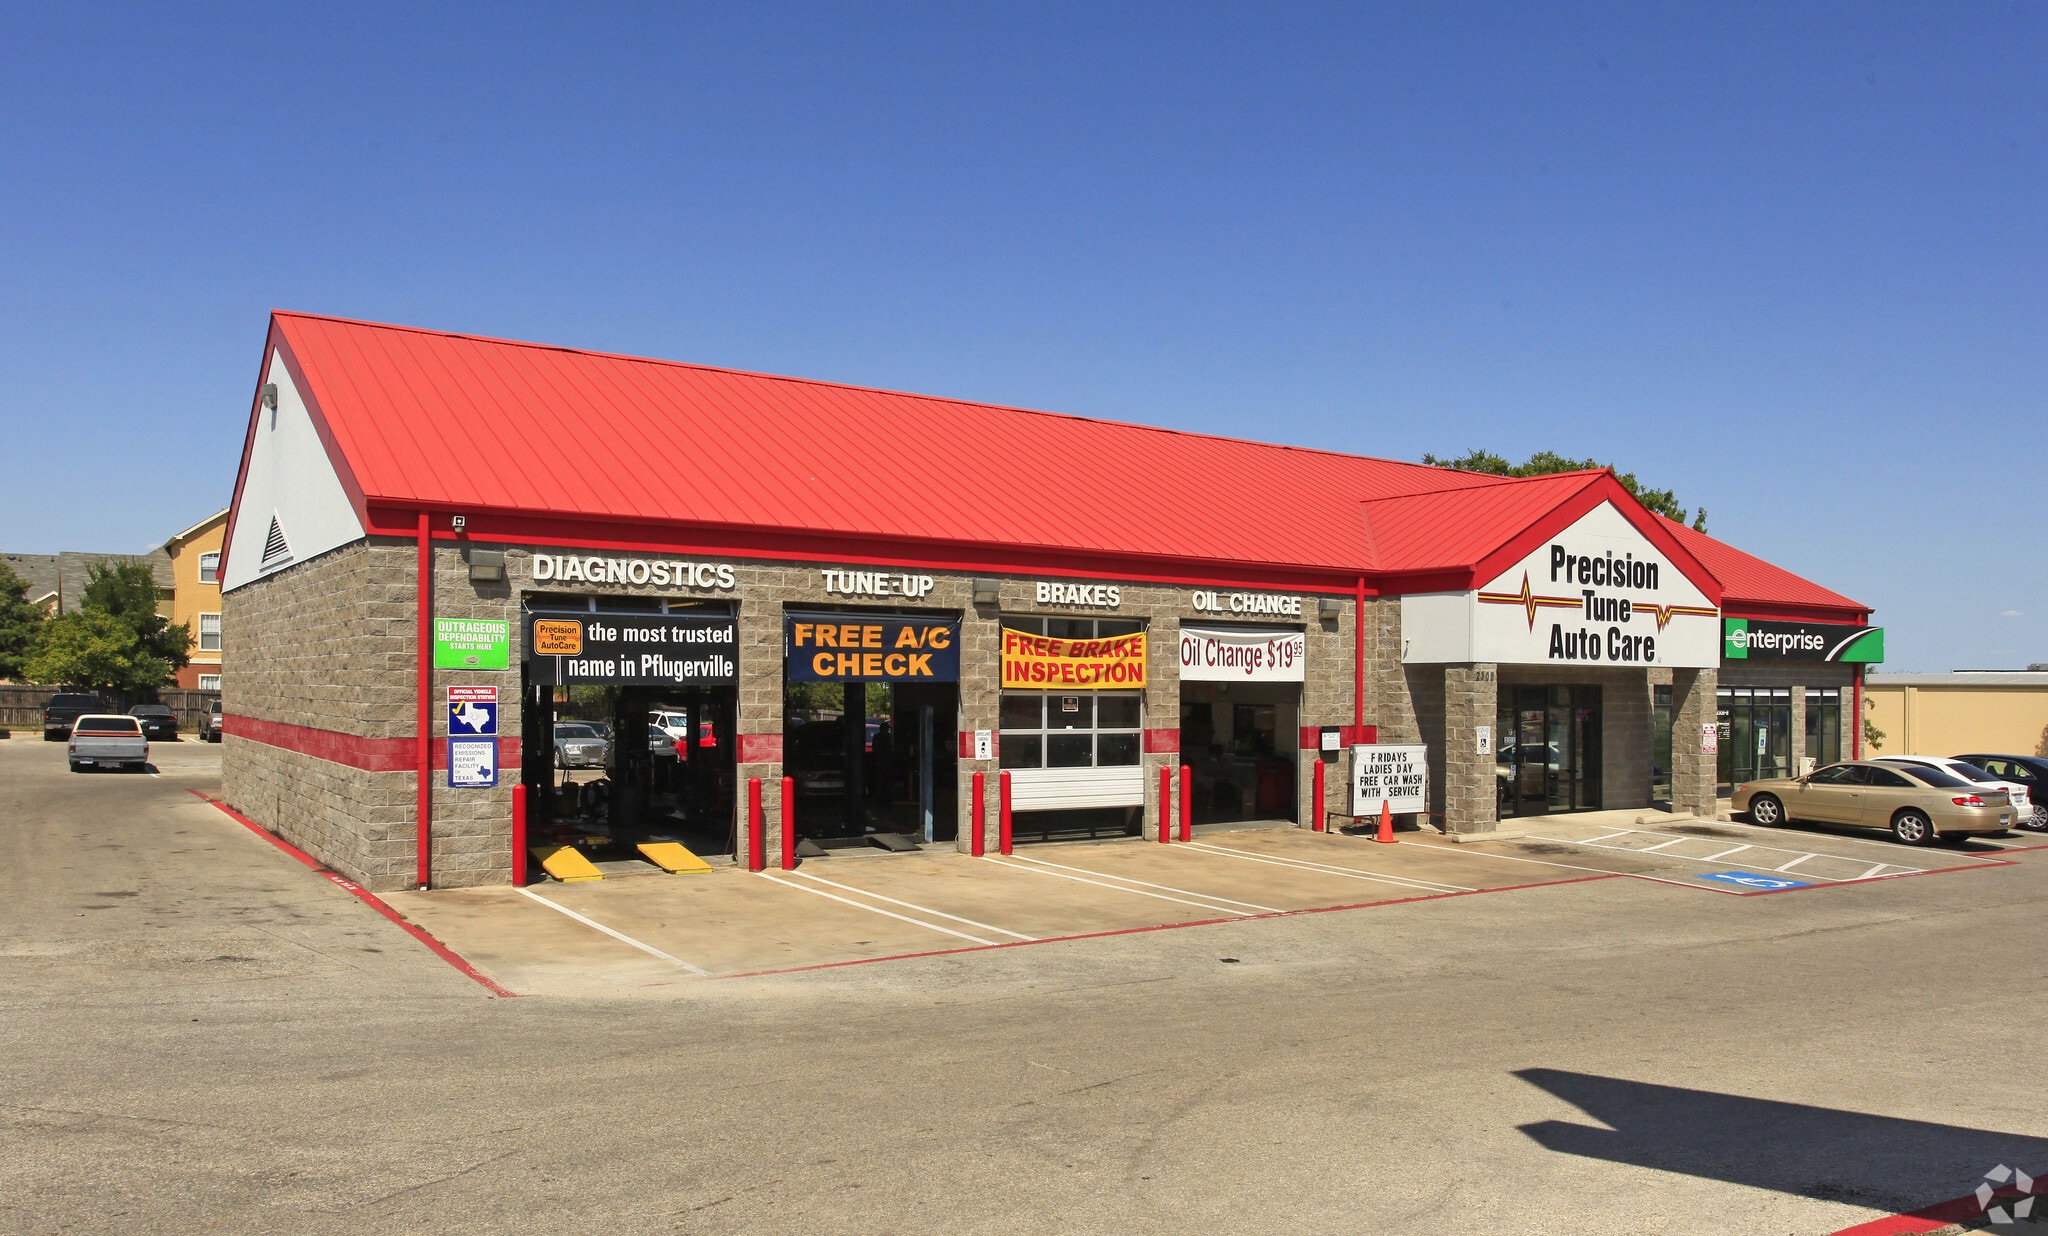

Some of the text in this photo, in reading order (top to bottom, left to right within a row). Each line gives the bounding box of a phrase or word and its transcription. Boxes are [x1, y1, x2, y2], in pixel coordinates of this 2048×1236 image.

[532, 554, 735, 589] DIAGNOSTICS
[1550, 544, 1659, 590] Precision
[821, 569, 934, 597] TUNE-UP
[1035, 581, 1121, 607] BRAKES
[1191, 590, 1302, 616] OIL CHANGE
[1582, 590, 1631, 623] Tune
[438, 621, 506, 633] OUTRAGEOUS
[438, 632, 506, 643] DEPENDABILITY
[540, 624, 577, 634] Precision
[550, 633, 568, 641] Tune
[587, 622, 733, 643] the most trusted
[794, 622, 951, 649] FREE A/C
[450, 642, 475, 650] STARTS
[541, 641, 577, 650] AutoCare
[1005, 633, 1143, 659] FREE BRAKE
[1549, 624, 1656, 663] Auto Care
[1728, 628, 1824, 655] enterprise
[568, 654, 734, 682] name in Pflugerville
[812, 652, 934, 677] CHECK
[1180, 637, 1201, 667] Oil
[1205, 638, 1263, 674] Change
[1005, 660, 1143, 683] INSPECTION
[1360, 774, 1423, 786] FREE CAR WASH
[1364, 763, 1413, 774] LADIES DAY
[1361, 786, 1420, 798] WITH SERVICE
